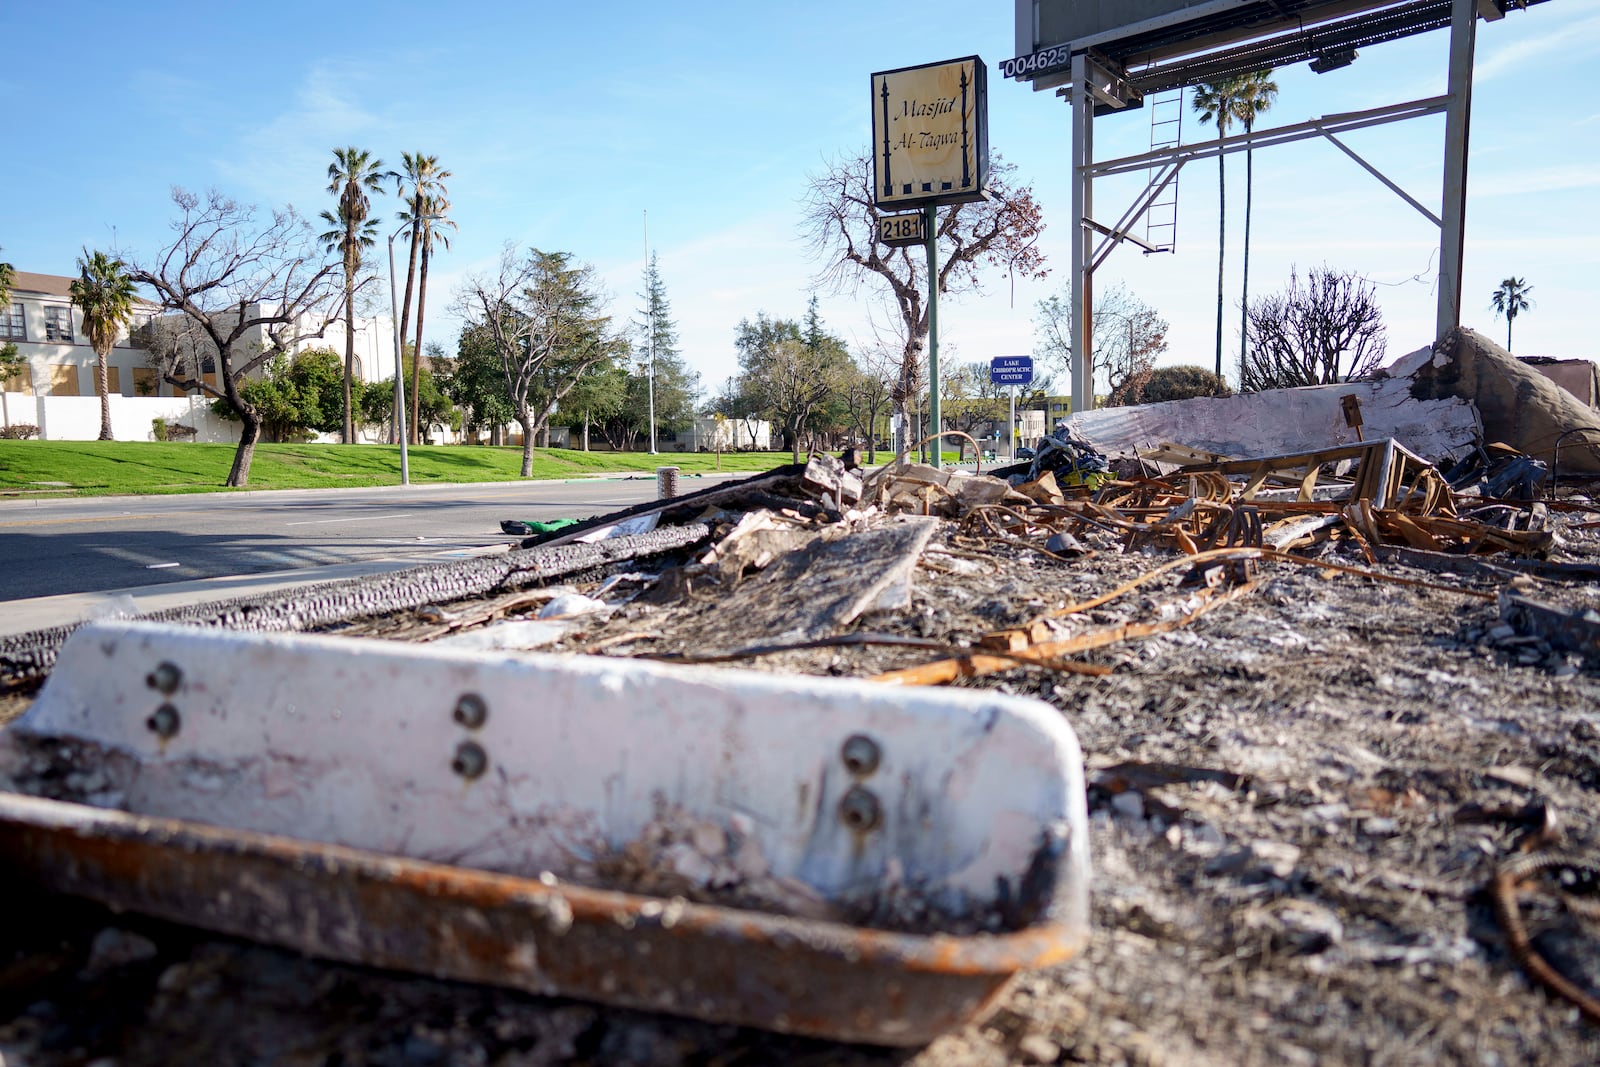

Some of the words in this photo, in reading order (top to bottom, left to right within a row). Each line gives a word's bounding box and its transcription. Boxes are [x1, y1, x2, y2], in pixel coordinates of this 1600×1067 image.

[1005, 46, 1067, 76] 004625
[893, 96, 956, 121] Masjid
[893, 132, 958, 150] Al-Taqwa
[883, 217, 919, 239] 2181
